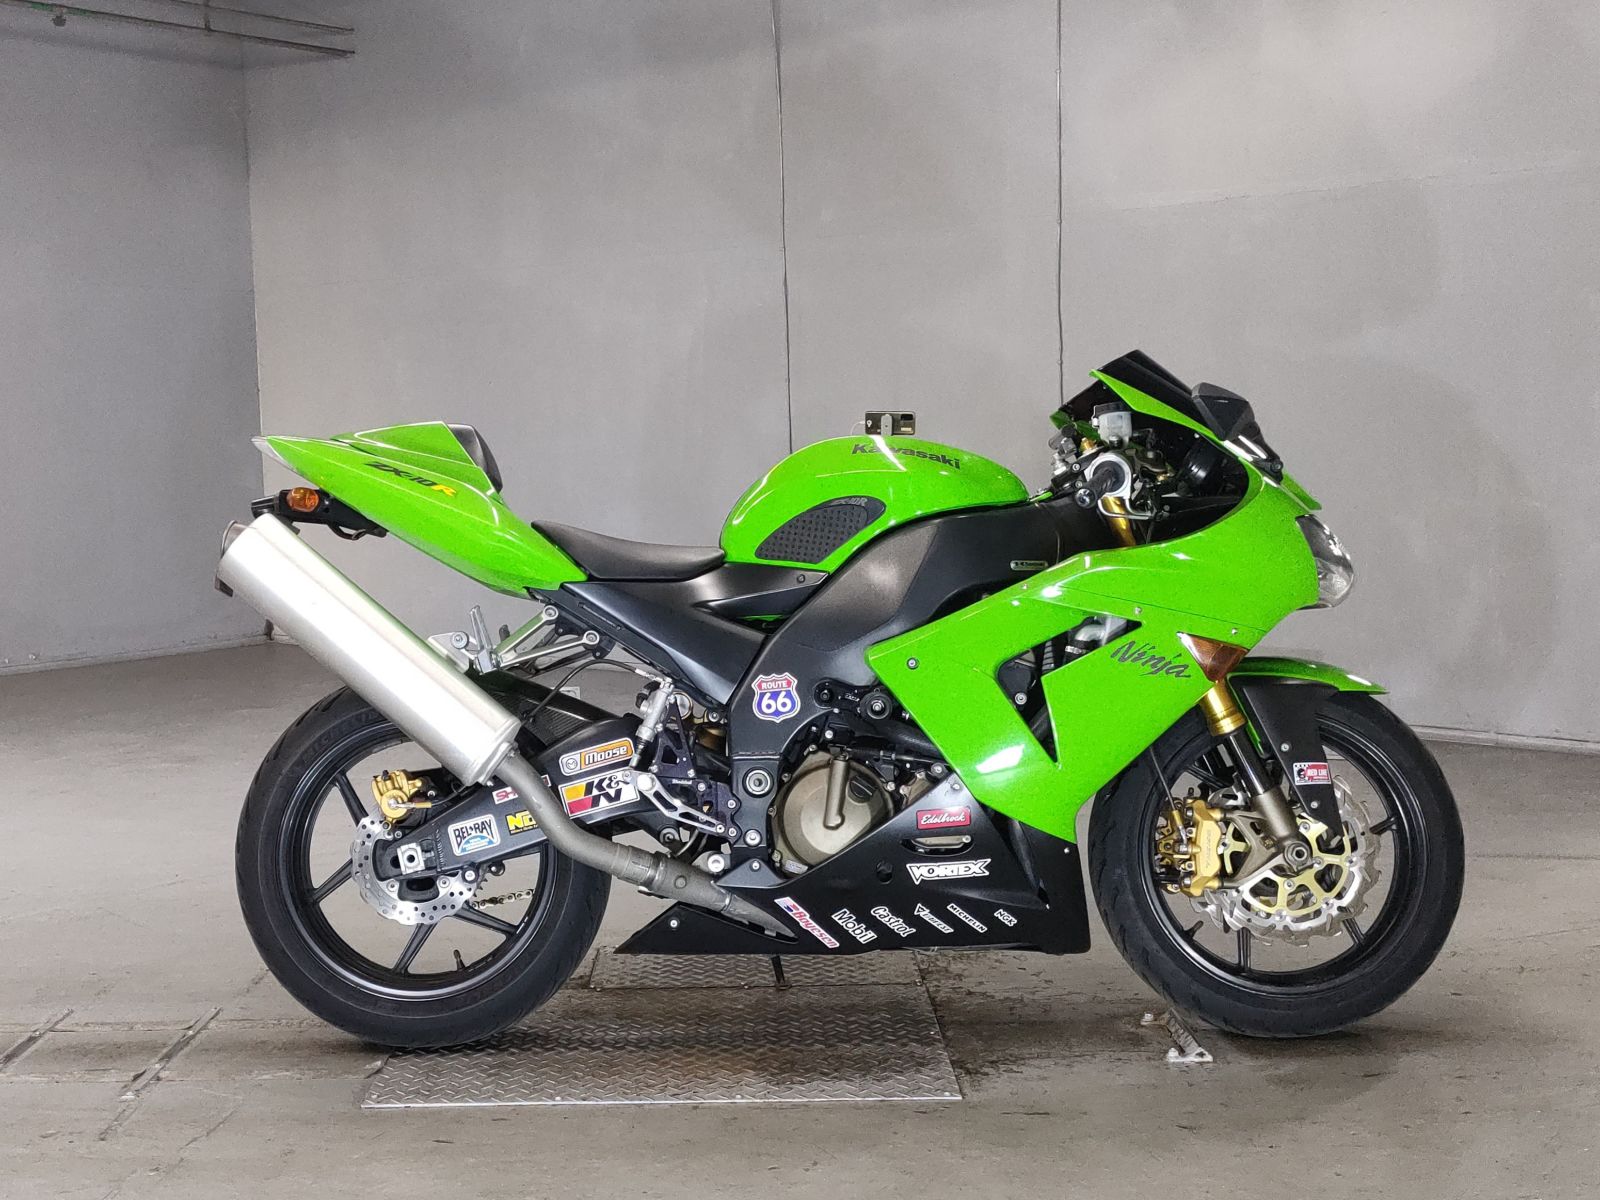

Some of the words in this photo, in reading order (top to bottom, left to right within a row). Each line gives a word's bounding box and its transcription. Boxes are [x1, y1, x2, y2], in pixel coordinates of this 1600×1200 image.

[1110, 640, 1192, 678] Ninja
[761, 680, 788, 690] ROUTE
[761, 691, 792, 714] 66
[585, 746, 627, 765] Moose
[921, 812, 966, 825] Edelbrock
[907, 859, 991, 884] VORTEX
[793, 910, 838, 947] Boyesen
[832, 908, 877, 944] Mobil
[872, 906, 916, 937] Castrol
[948, 904, 987, 932] MICHELIN
[995, 909, 1017, 927] NGK
